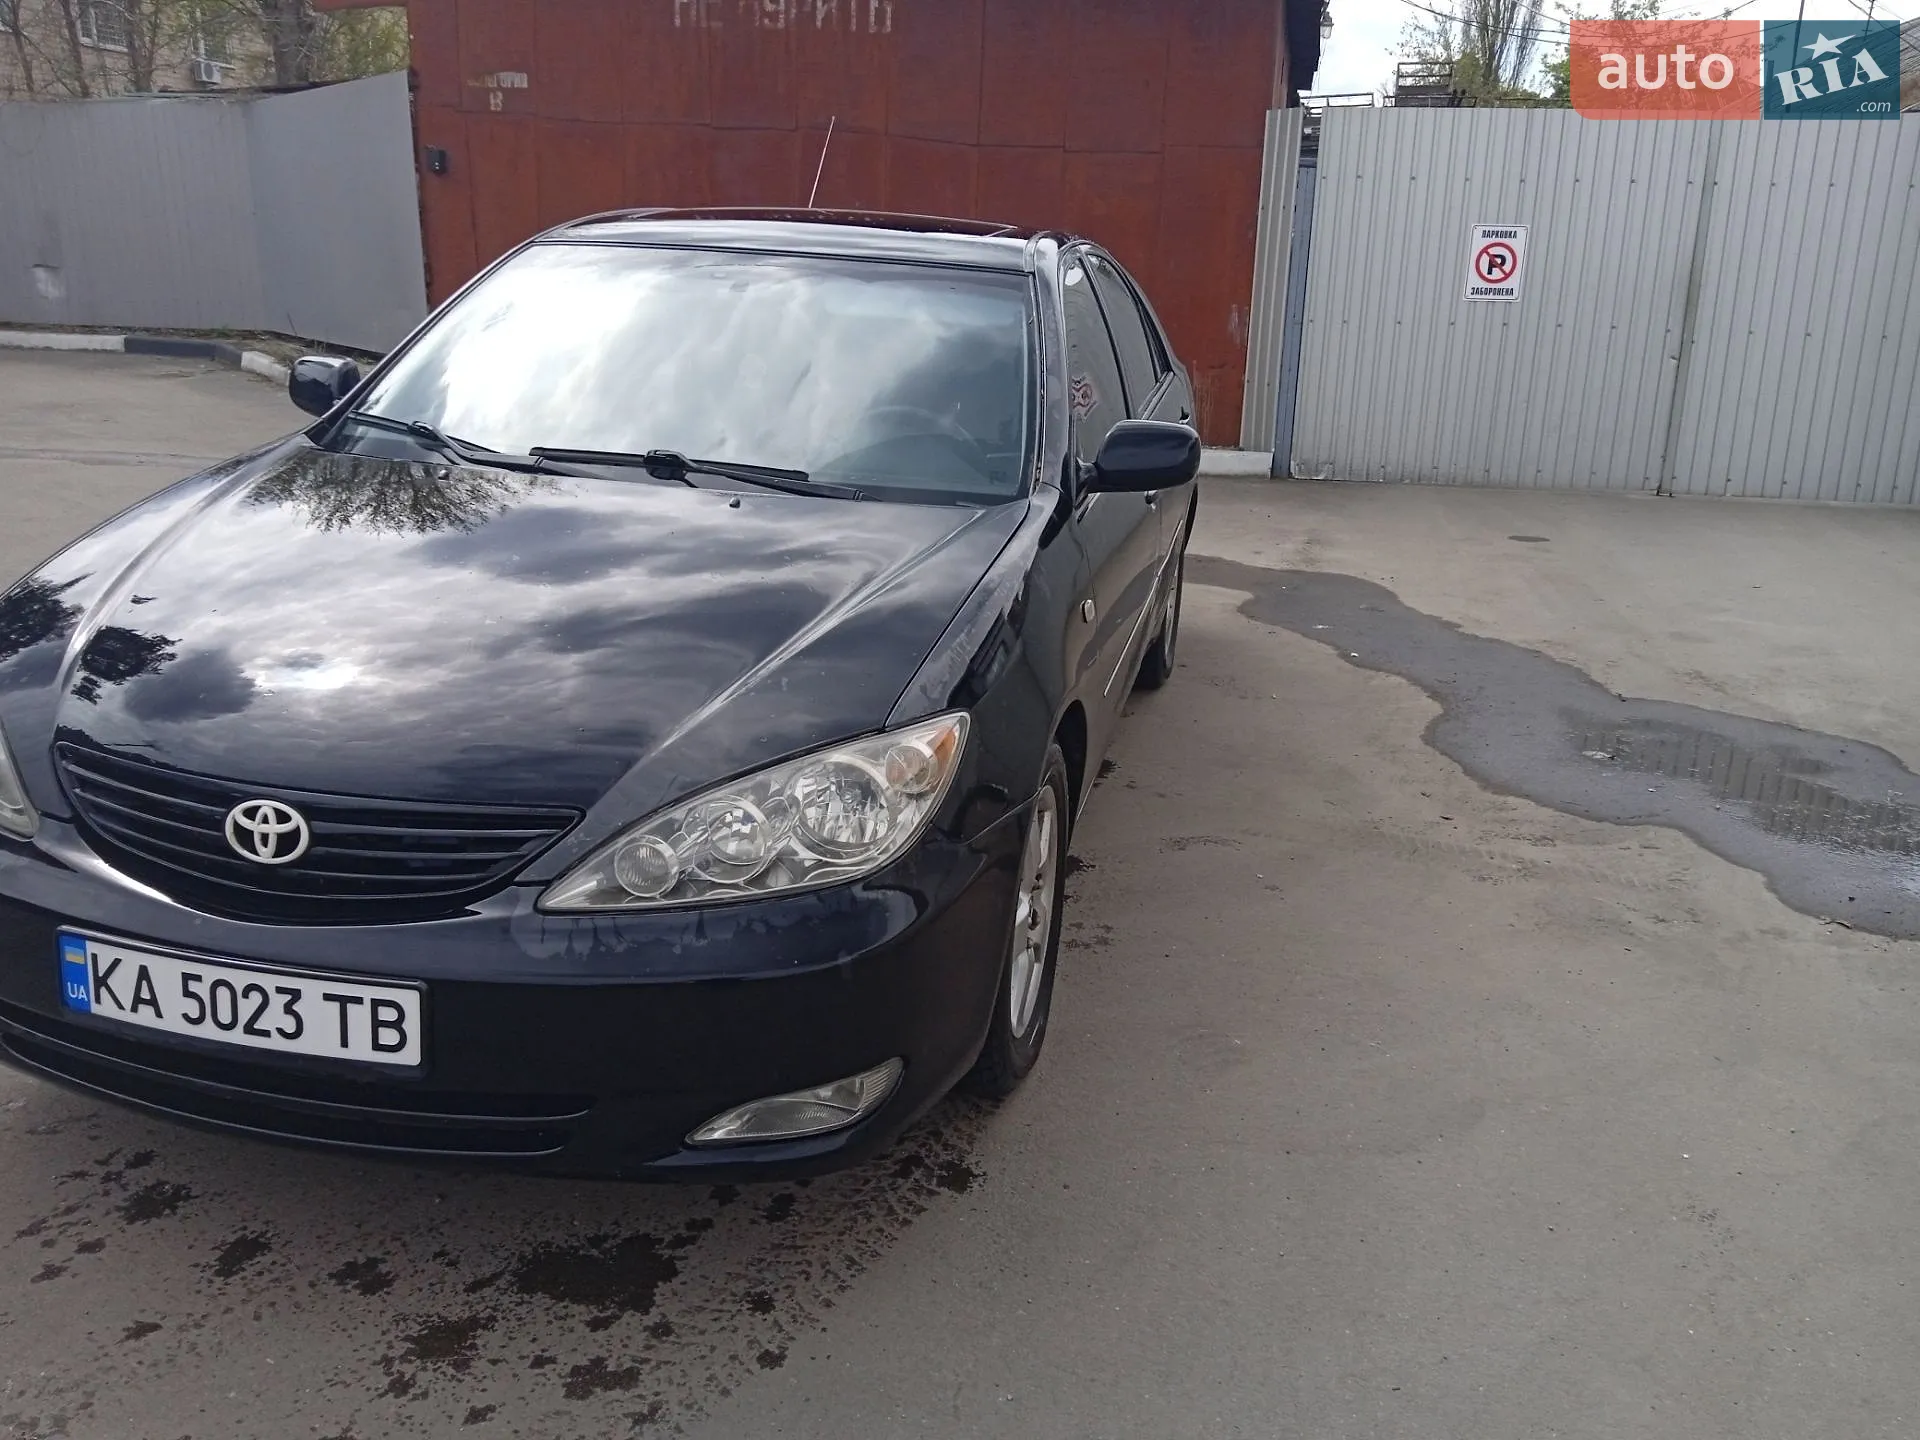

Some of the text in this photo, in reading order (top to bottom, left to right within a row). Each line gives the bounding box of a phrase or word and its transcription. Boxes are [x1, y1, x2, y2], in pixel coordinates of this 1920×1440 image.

[1481, 229, 1518, 239] ПАРКОВКА
[1470, 287, 1514, 296] ЗАБОРОНЕНА
[67, 982, 88, 1001] UA
[90, 952, 407, 1053] KA 5023 TB
